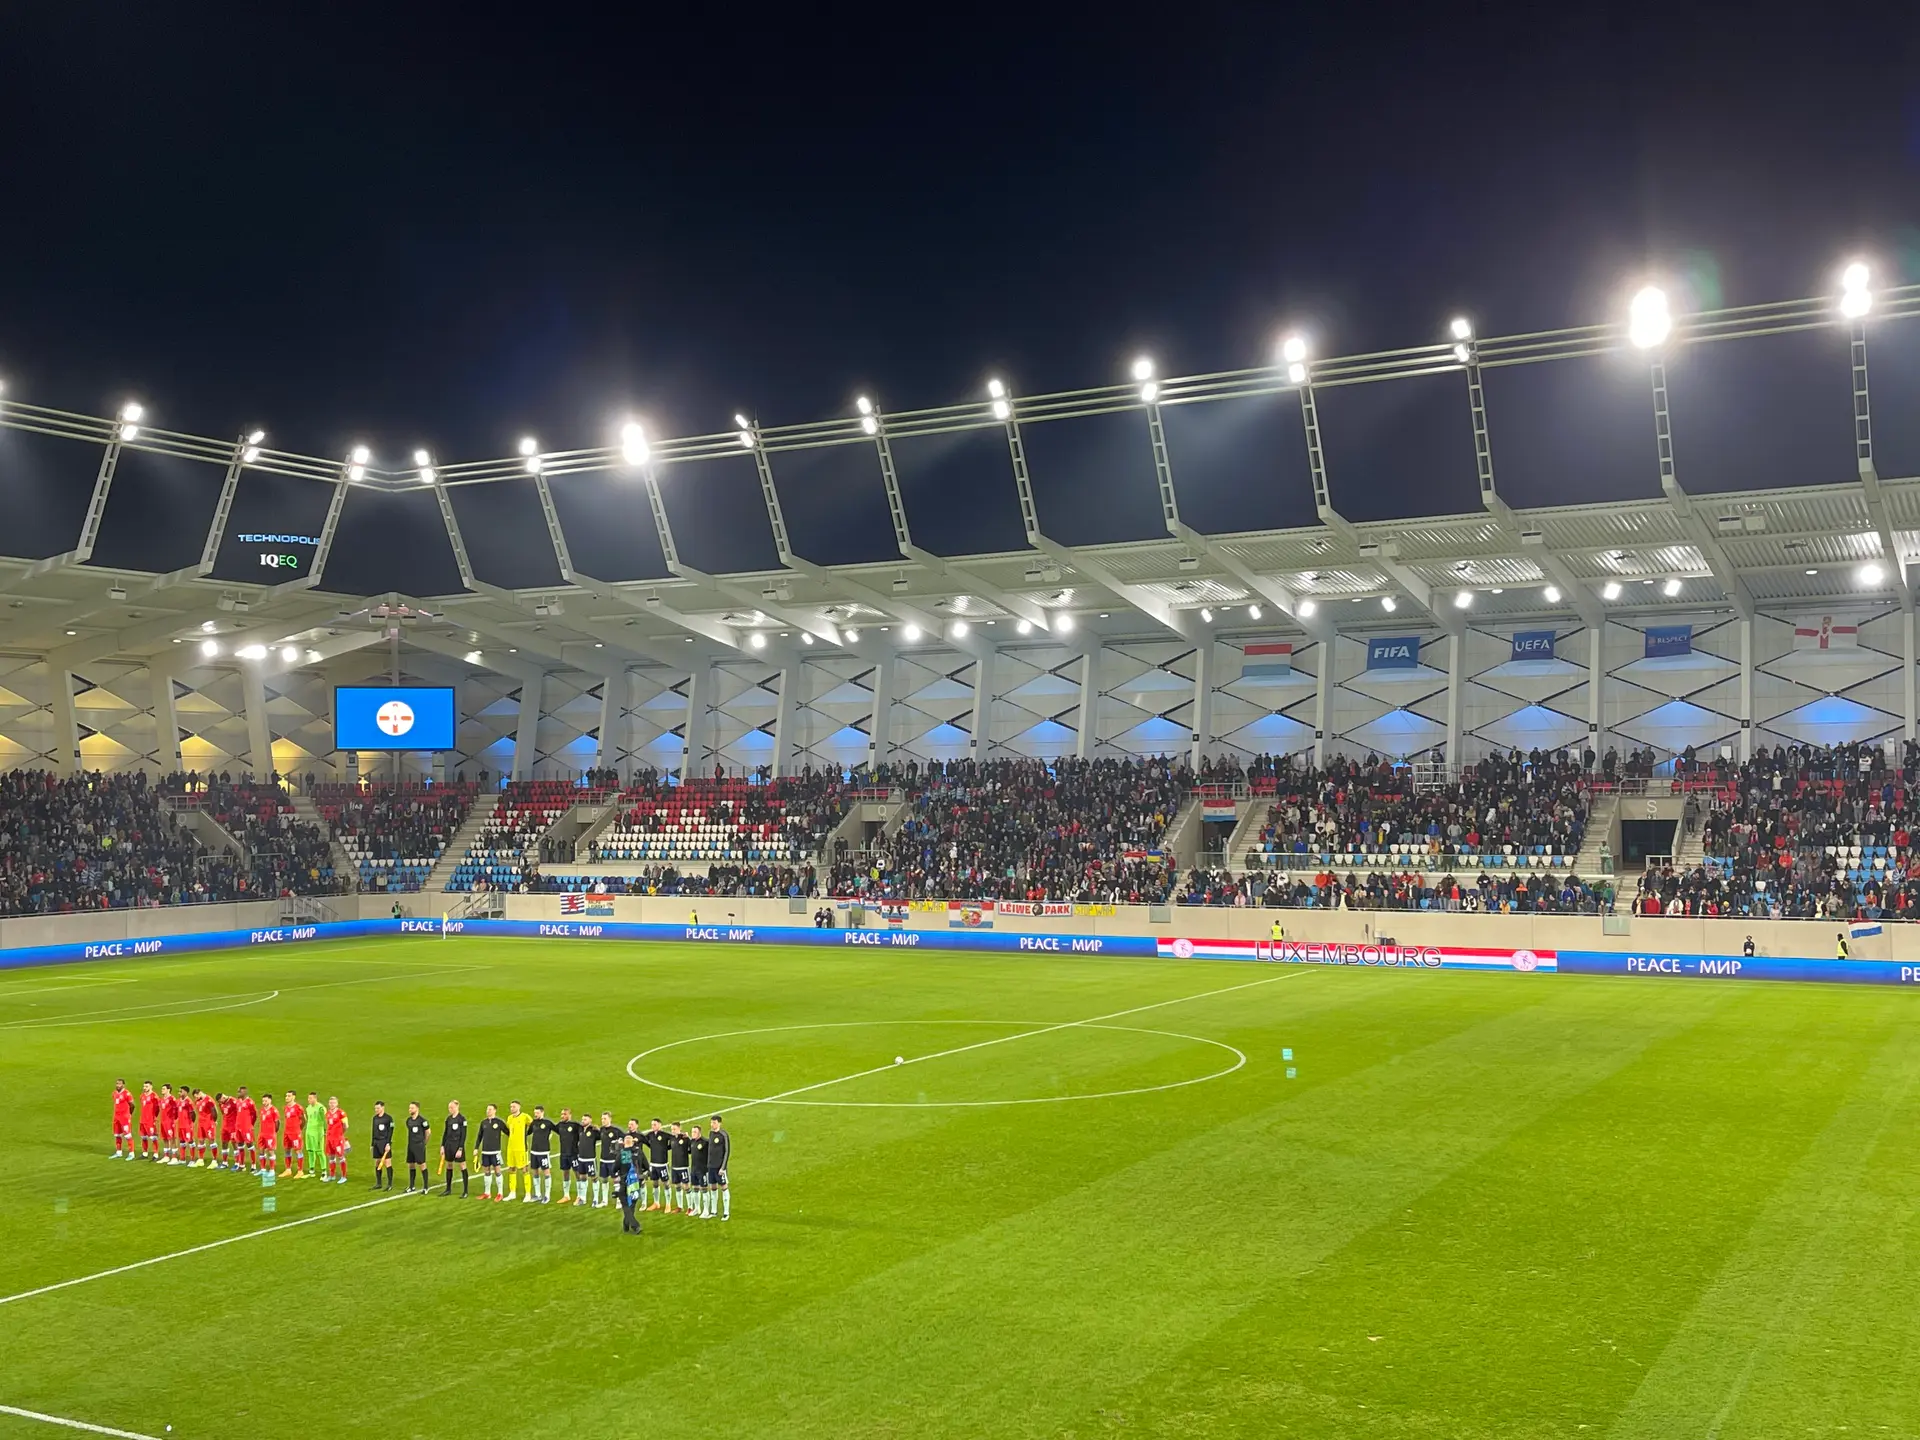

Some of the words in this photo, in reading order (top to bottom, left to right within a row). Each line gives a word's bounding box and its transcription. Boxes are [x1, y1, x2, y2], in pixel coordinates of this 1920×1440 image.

[260, 554, 298, 568] IQEQ
[1374, 645, 1410, 659] FIFA
[1515, 639, 1550, 652] UEFA
[1647, 800, 1657, 813] S
[1045, 904, 1070, 914] PARK
[401, 921, 434, 931] PEACE
[539, 924, 570, 935] PEACE
[579, 925, 603, 936] МИР
[251, 930, 283, 943] PEACE
[292, 927, 316, 940] МИР
[686, 928, 719, 940] PEACE
[845, 932, 881, 944] PEACE
[892, 933, 919, 946] МИР
[85, 943, 123, 958] PEACE
[134, 940, 162, 954] МИР
[1020, 937, 1060, 950] PEACE
[1072, 939, 1103, 952] МИР
[1255, 942, 1442, 967] LUXEMBOURG
[1627, 957, 1681, 973] PEACE
[1700, 959, 1742, 975] МИР
